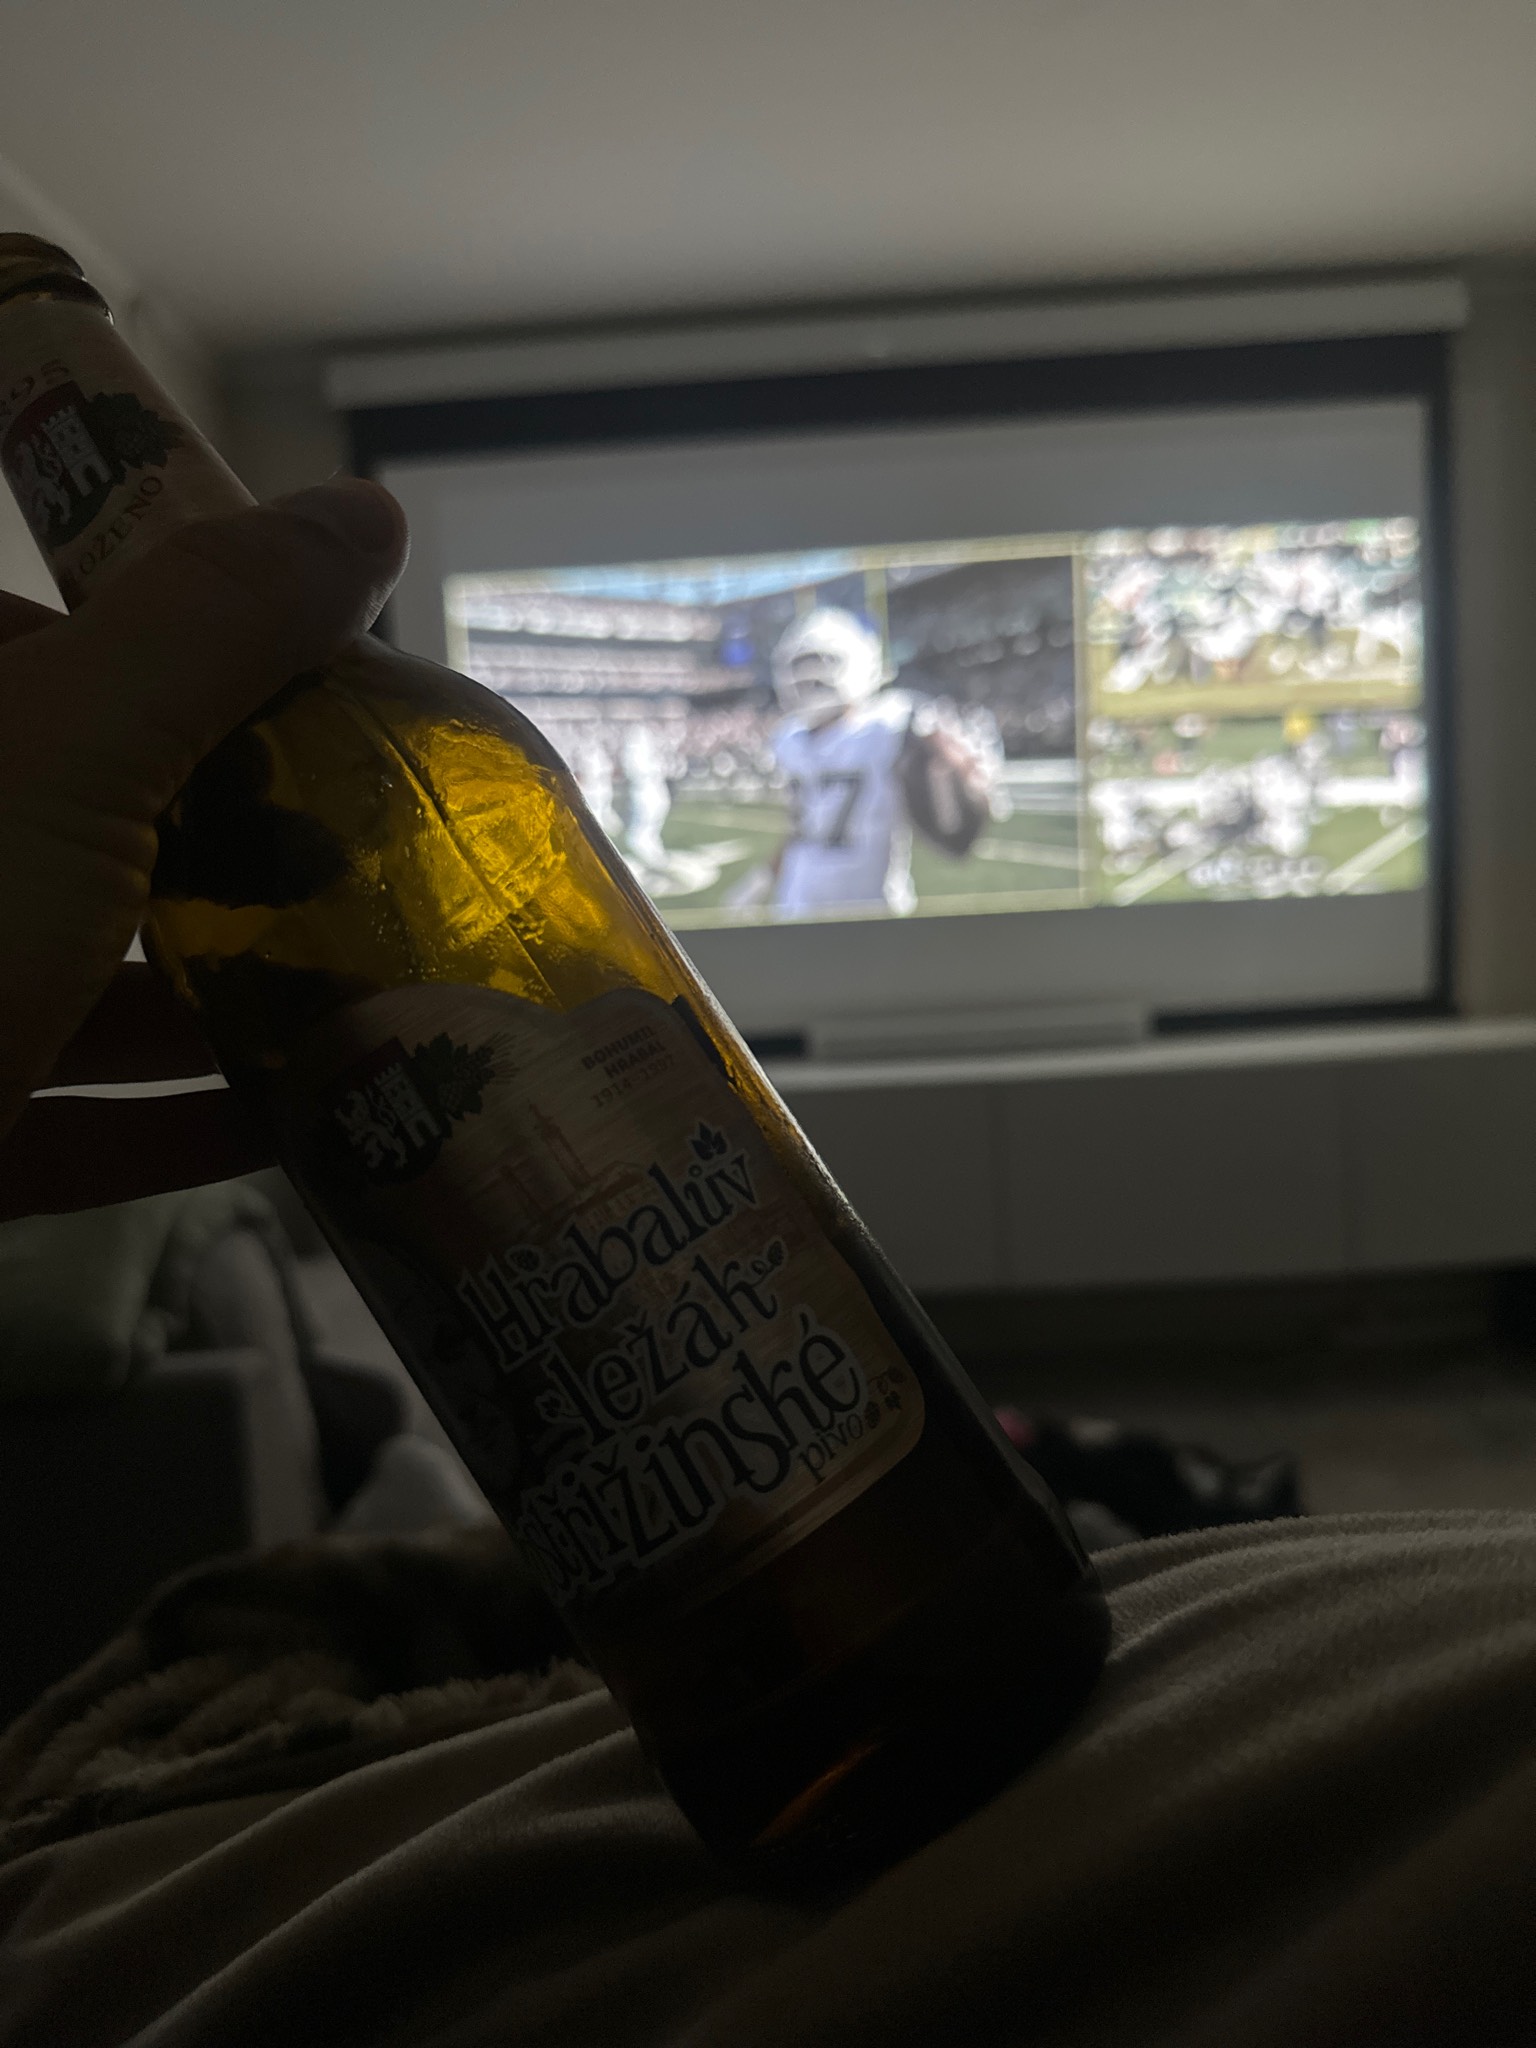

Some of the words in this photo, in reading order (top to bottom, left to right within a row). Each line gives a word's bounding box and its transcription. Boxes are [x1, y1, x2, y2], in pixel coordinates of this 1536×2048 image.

[603, 1041, 667, 1079] HRABAL
[542, 1245, 786, 1447] ležák
[796, 1415, 863, 1484] pivo
